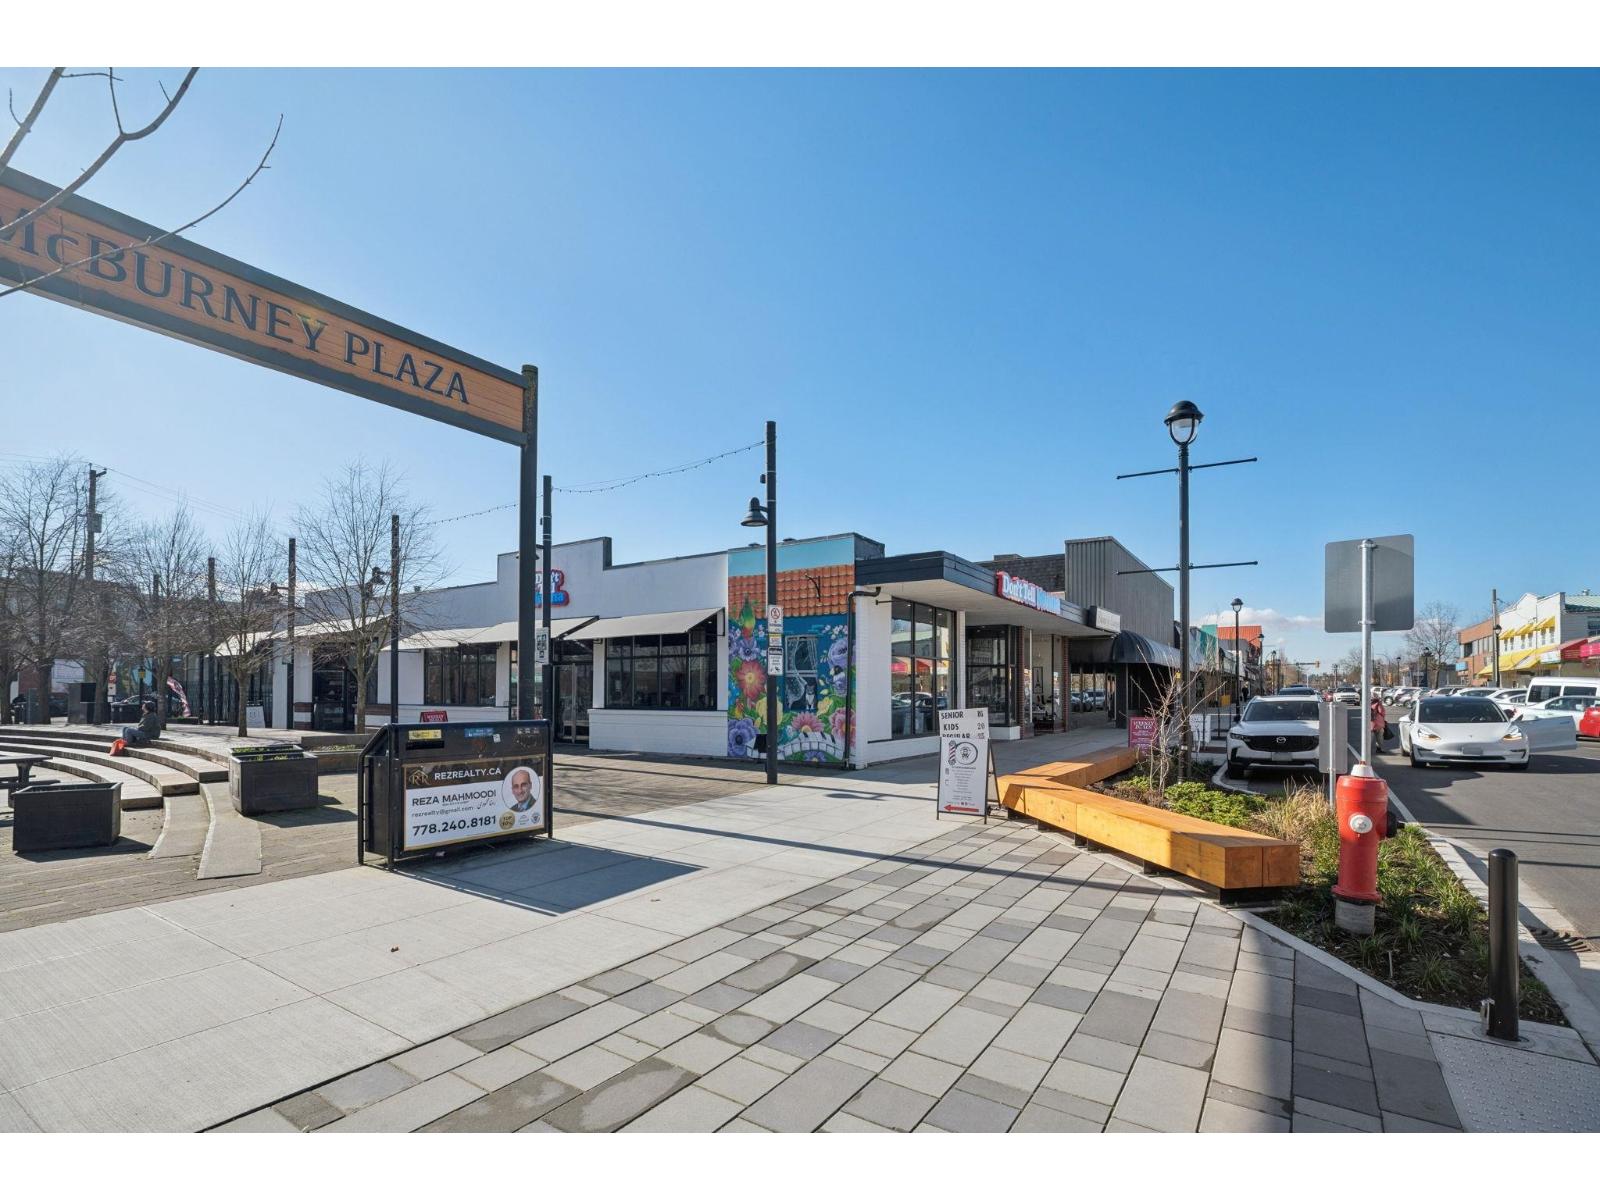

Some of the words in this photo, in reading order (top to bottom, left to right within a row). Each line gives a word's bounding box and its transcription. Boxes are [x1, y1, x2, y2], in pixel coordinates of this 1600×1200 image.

[344, 331, 470, 404] PLAZA
[941, 711, 964, 720] SENIOR
[943, 723, 959, 731] KIDS
[434, 768, 501, 780] REZREALTY.CA
[412, 797, 440, 807] REZA
[442, 790, 496, 802] MAHMOODI
[413, 815, 497, 837] 778.240.8181
